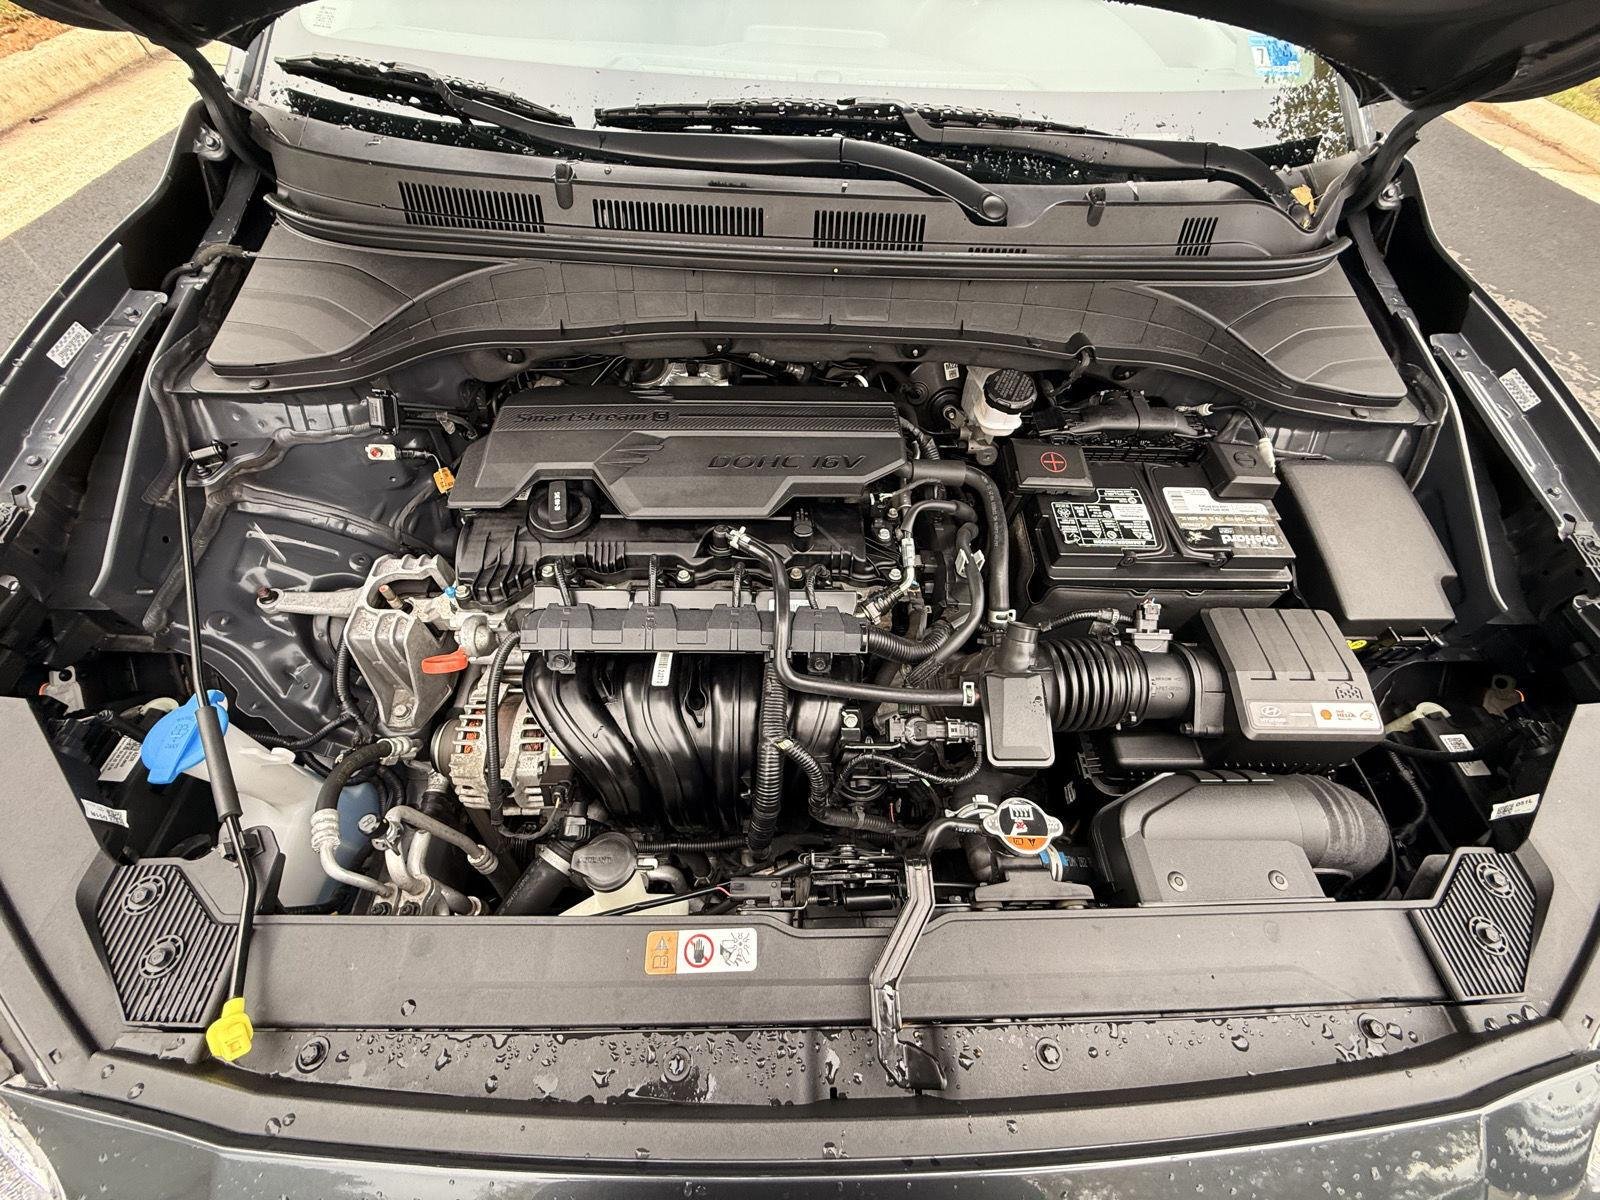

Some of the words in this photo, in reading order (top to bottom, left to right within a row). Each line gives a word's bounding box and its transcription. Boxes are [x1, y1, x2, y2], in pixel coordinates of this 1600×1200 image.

[514, 411, 648, 424] Smartstream
[707, 454, 801, 470] DOHC
[811, 454, 867, 470] 16V
[1220, 533, 1279, 546] DieHard
